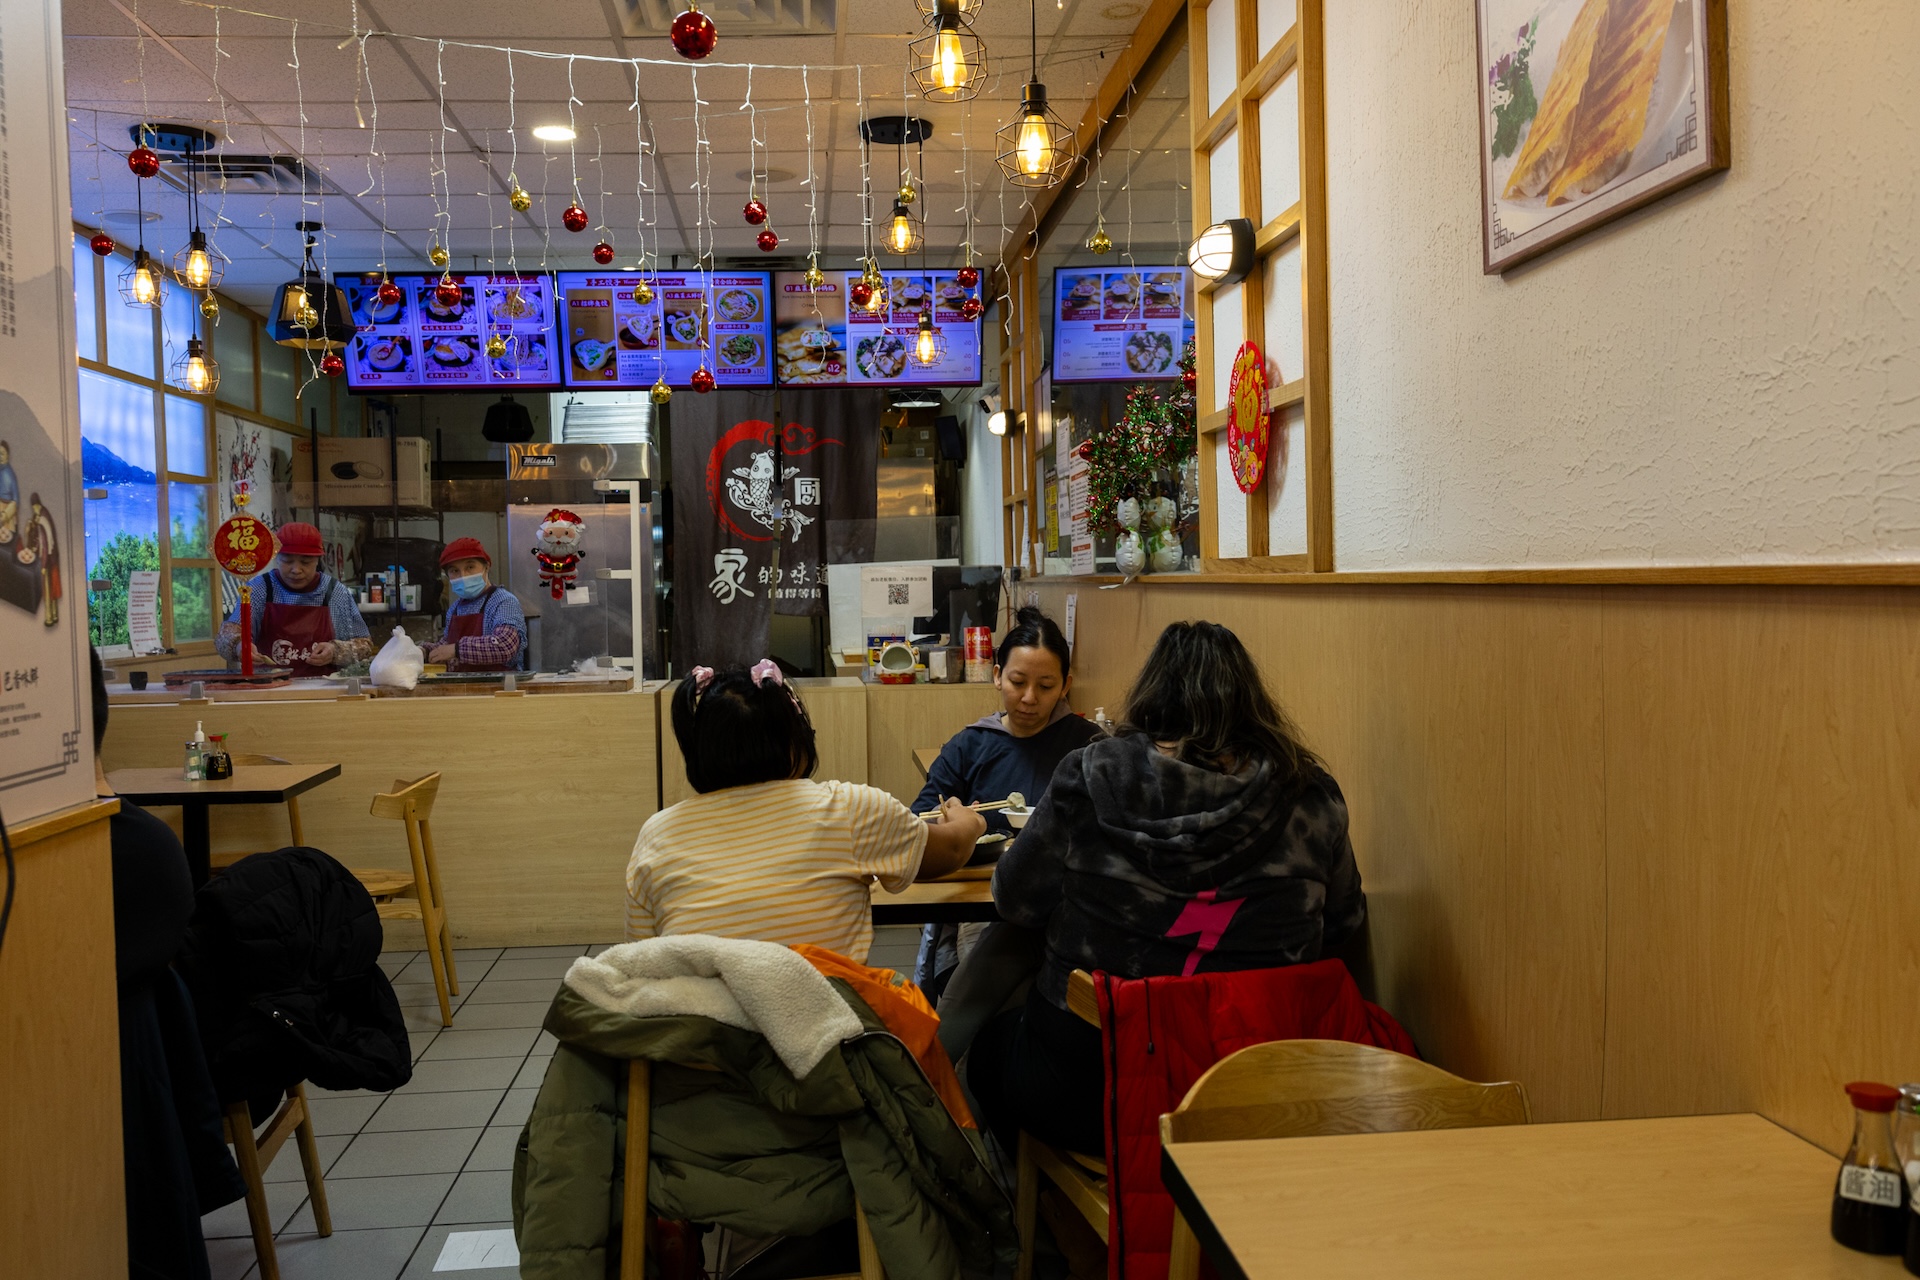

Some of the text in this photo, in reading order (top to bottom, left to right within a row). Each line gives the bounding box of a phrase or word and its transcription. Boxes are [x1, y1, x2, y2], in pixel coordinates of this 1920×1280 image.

[590, 278, 622, 287] 手工饺子
[523, 456, 555, 465] Migali
[794, 476, 822, 507] 厨
[226, 519, 261, 551] 福
